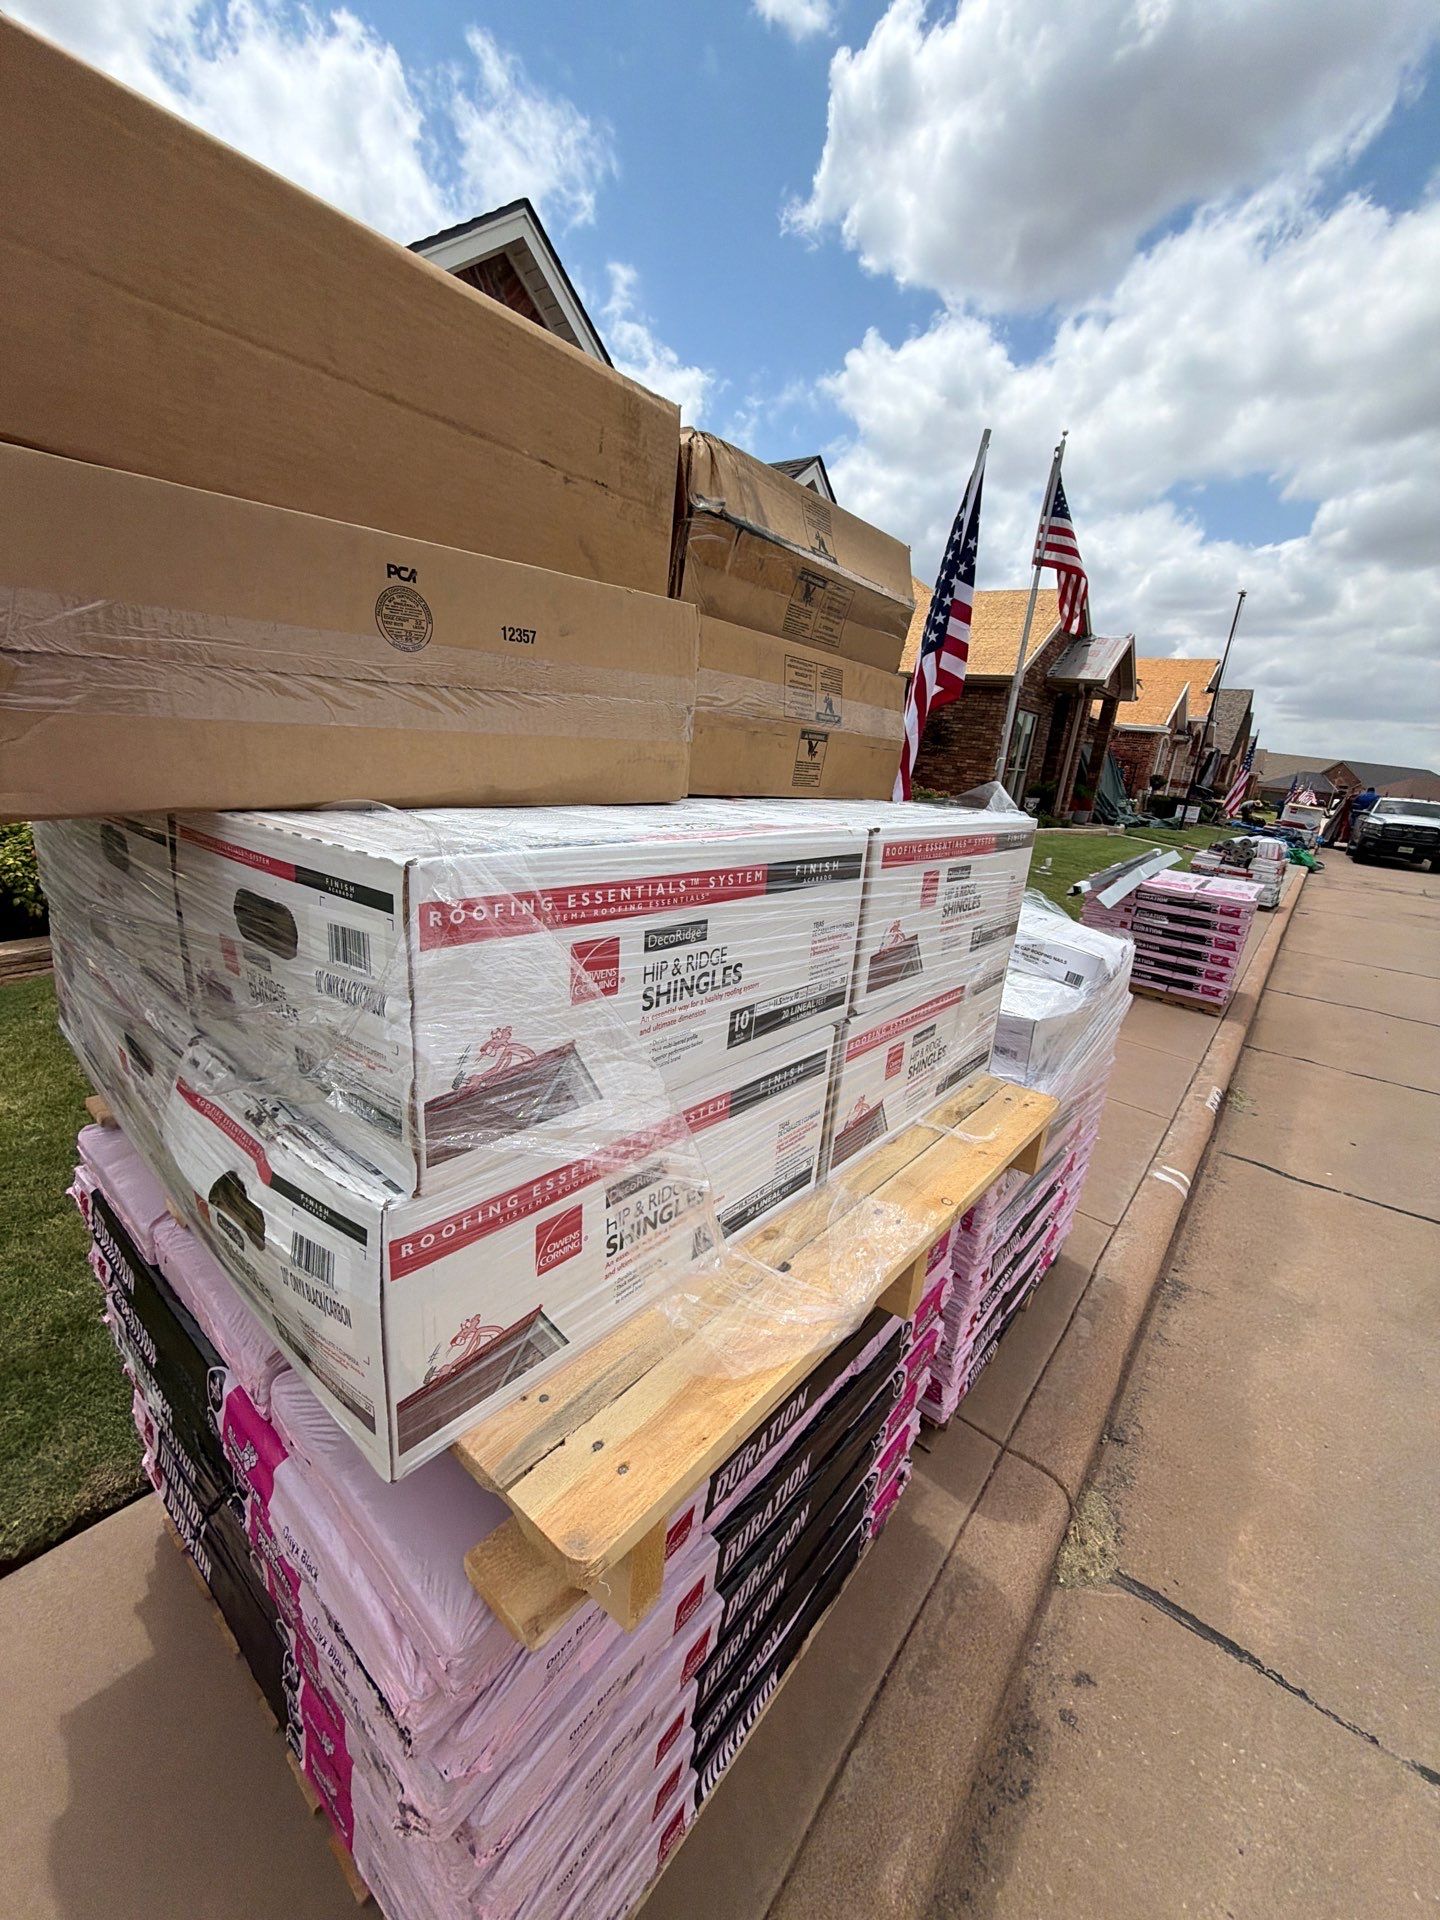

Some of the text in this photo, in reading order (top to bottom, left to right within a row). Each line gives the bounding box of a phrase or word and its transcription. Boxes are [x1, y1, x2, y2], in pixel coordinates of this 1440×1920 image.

[386, 563, 418, 583] PCA
[501, 626, 537, 644] 12357
[885, 844, 923, 857] ROOFING
[795, 860, 839, 876] FINISH
[325, 877, 355, 893] FINISH
[429, 897, 553, 928] ROOFING
[709, 870, 763, 889] SYSTEM
[594, 902, 643, 916] ROOFING
[643, 946, 728, 984] HIP & RIDGE
[642, 963, 743, 1011] SHINGLES
[724, 987, 742, 998] roofing
[735, 1010, 750, 1032] 10
[791, 999, 815, 1016] LINEAL
[640, 1027, 651, 1036] and
[908, 1045, 947, 1080] SHINGLES
[759, 1063, 804, 1092] FINISH
[300, 1193, 329, 1217] FINISH
[499, 1195, 551, 1224] SISTEMA
[401, 1194, 519, 1258] ROOFING
[607, 1207, 630, 1234] HIP
[539, 1240, 581, 1267] CORNING
[547, 1230, 581, 1254] OWENS
[714, 1385, 811, 1506] DURATION
[723, 1453, 812, 1575] DURATION
[283, 1526, 319, 1584] Onyx Black
[725, 1503, 811, 1628] DURATION
[702, 1568, 788, 1698] DURATION
[311, 1617, 348, 1679] Onyx Black
